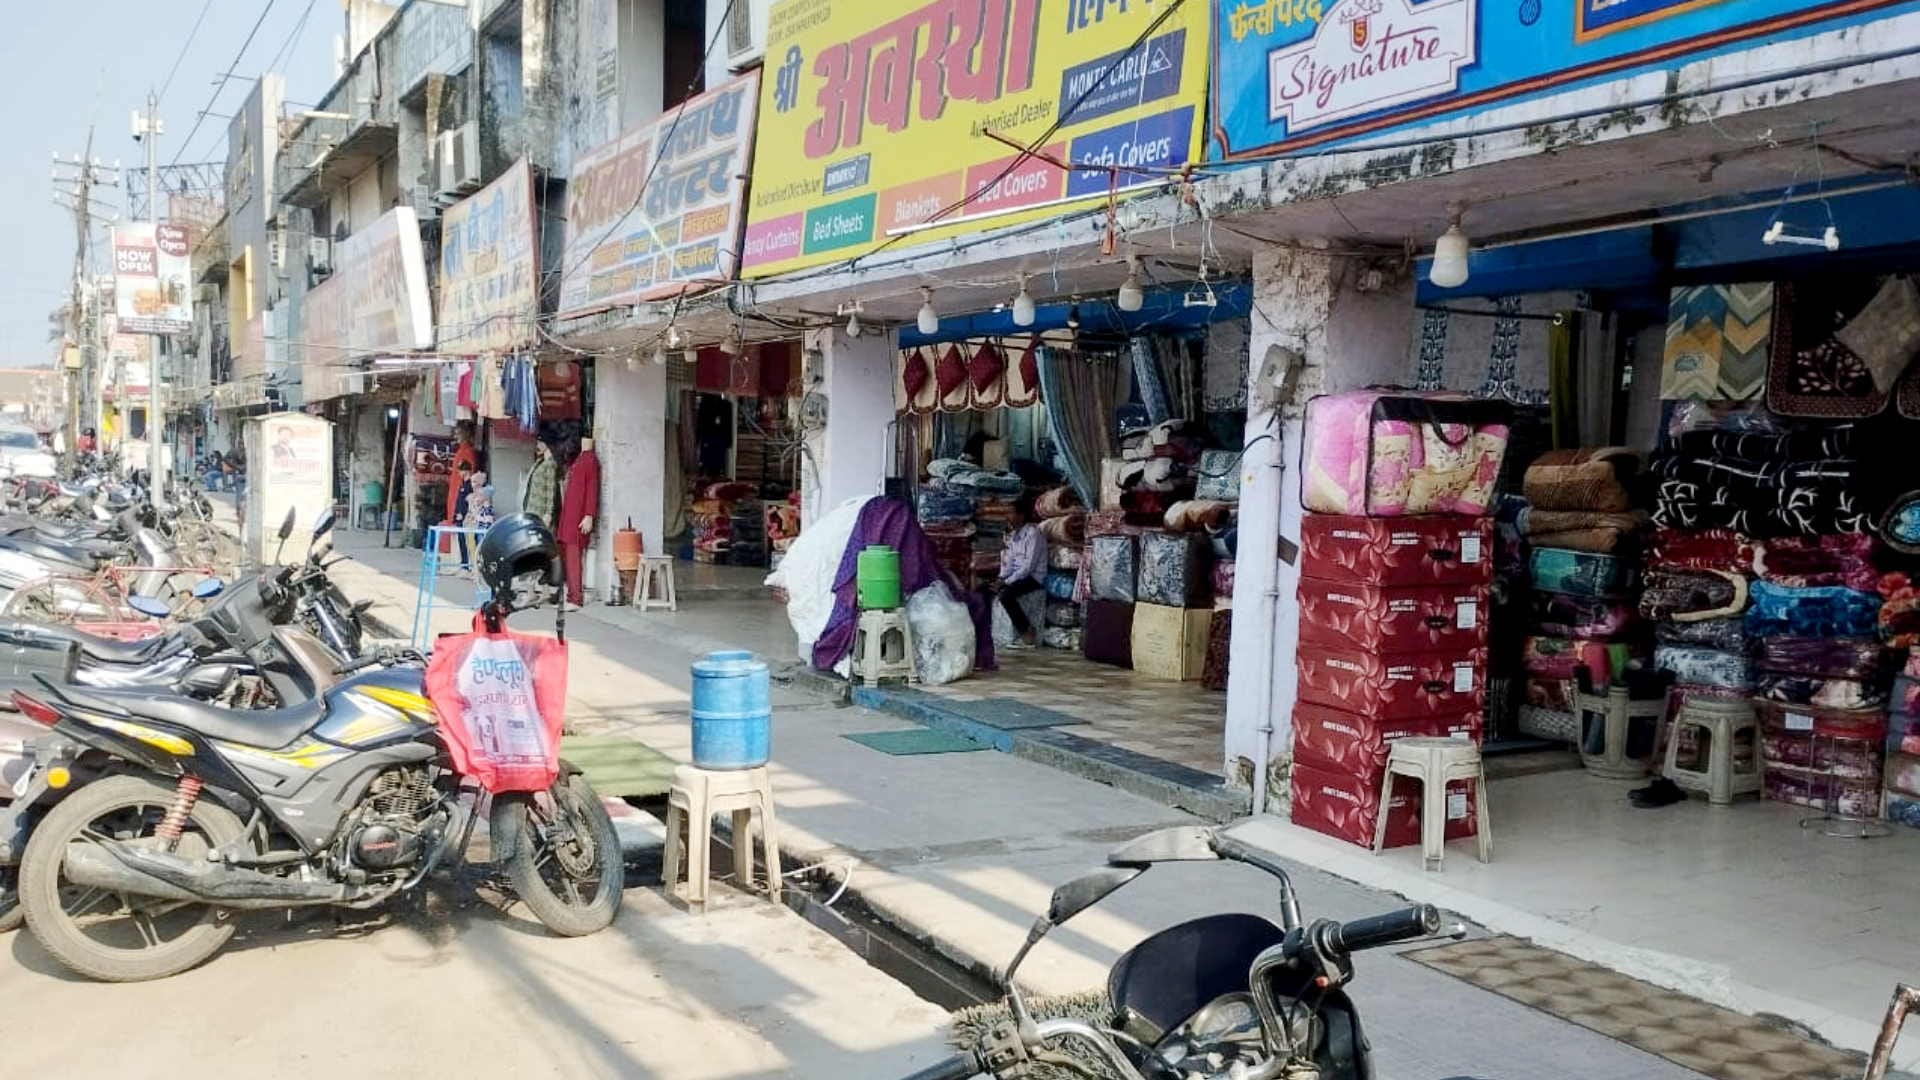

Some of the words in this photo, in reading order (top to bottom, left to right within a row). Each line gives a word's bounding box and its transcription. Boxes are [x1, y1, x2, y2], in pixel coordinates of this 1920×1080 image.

[1068, 66, 1107, 99] MONTE
[1110, 52, 1148, 86] CARLO
[1280, 23, 1456, 109] Signature
[1082, 148, 1115, 180] Sofa
[1118, 137, 1171, 167] Covers
[1004, 169, 1048, 198] Covers
[895, 194, 941, 222] Blankets
[813, 218, 832, 241] Bed
[832, 212, 865, 238] Sheets
[117, 250, 152, 262] NOW
[117, 261, 152, 273] OPEN
